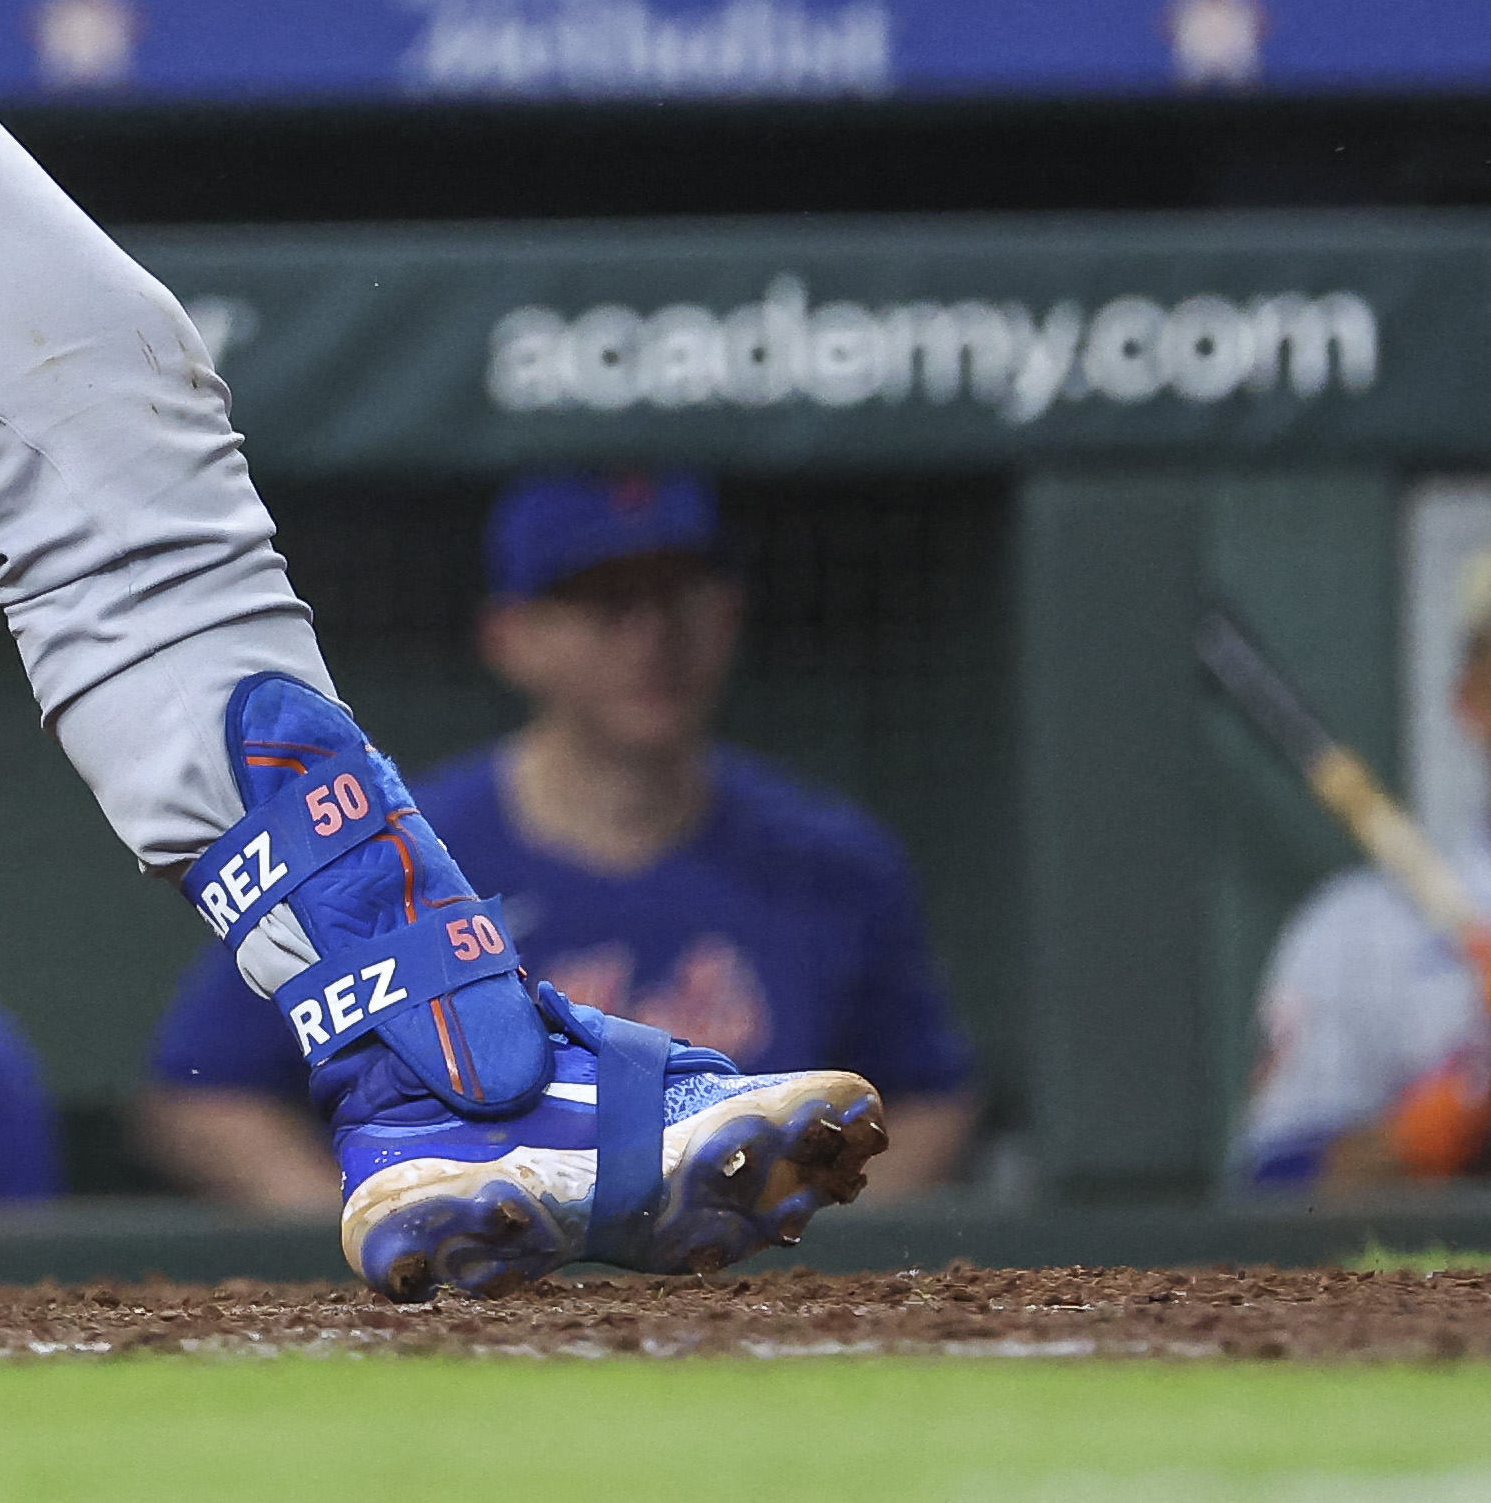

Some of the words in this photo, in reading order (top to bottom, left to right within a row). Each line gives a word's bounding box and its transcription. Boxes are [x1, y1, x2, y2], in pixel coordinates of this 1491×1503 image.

[485, 273, 1379, 425] academy.com
[196, 830, 288, 941] REZ
[305, 773, 370, 838] 50
[445, 913, 505, 962] 50
